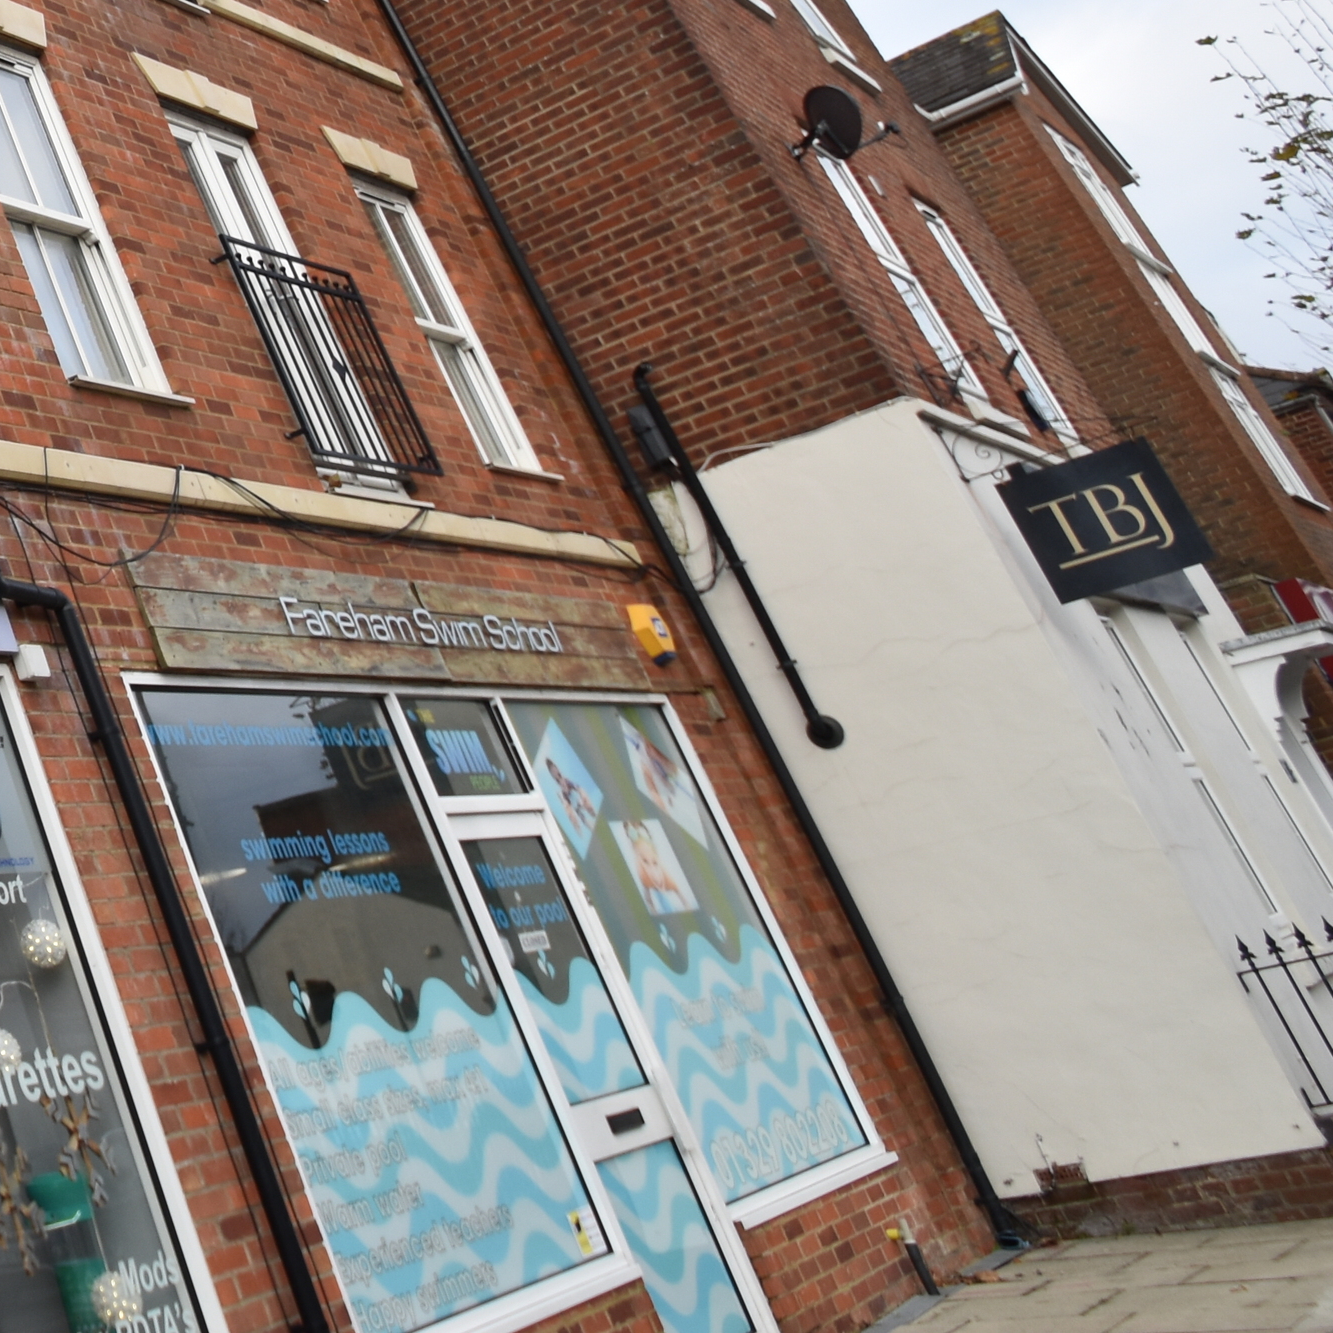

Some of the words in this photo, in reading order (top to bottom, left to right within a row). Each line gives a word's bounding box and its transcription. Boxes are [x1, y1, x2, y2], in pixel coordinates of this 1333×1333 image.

[1026, 472, 1175, 551] TBJ
[278, 595, 416, 643] Fareham
[412, 607, 487, 649] Swim
[482, 614, 564, 653] School
[240, 829, 332, 864] swimming
[328, 829, 390, 855] lessons
[260, 872, 302, 905] with
[321, 869, 402, 899] difference
[476, 862, 546, 890] Welcome
[535, 896, 568, 929] pool
[117, 1249, 181, 1297] Mods
